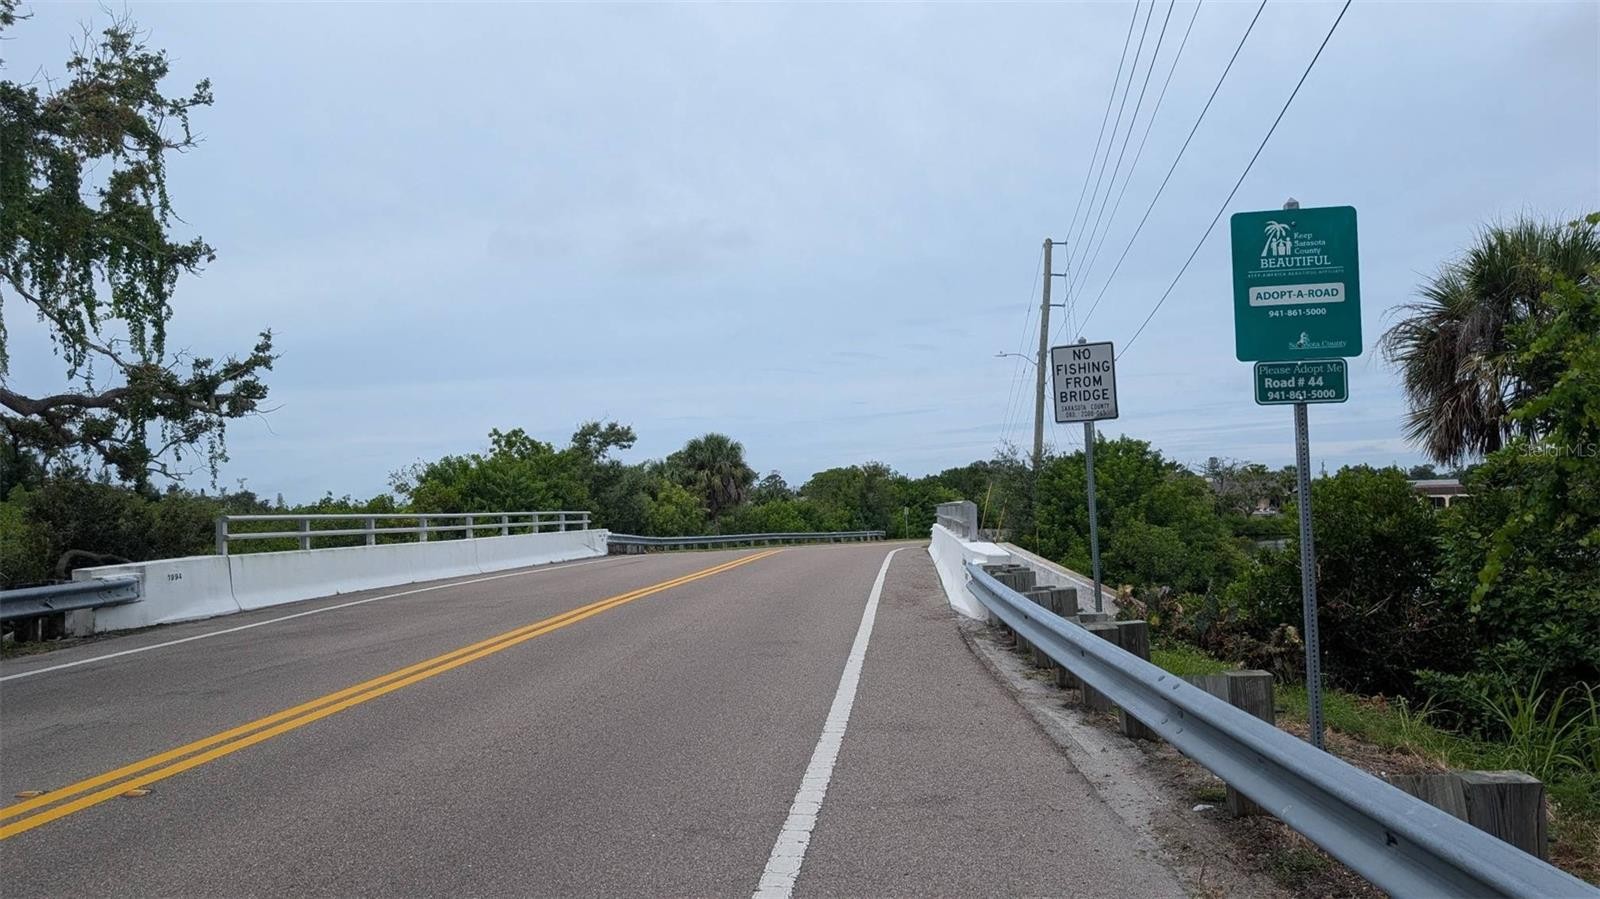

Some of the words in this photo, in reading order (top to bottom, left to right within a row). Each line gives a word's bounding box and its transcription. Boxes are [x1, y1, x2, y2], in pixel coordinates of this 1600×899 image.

[1294, 232, 1313, 240] Keep
[1294, 239, 1326, 247] Sarasota
[1294, 247, 1321, 255] County
[1260, 255, 1332, 269] BEAUTIFUL
[1255, 288, 1339, 301] ADOPT-A-ROAD
[1268, 307, 1327, 318] 941-861-5000
[1073, 348, 1091, 361] NO
[1056, 360, 1110, 376] FISHING
[1259, 366, 1291, 375] Please
[1293, 364, 1324, 375] Adopt
[1327, 363, 1343, 373] Me
[1065, 375, 1103, 389] FROM
[1264, 377, 1295, 388] Road
[1297, 377, 1305, 387] #
[1308, 376, 1324, 387] 44
[1060, 388, 1110, 403] BRIDGE
[1267, 389, 1336, 400] 941-861-5000
[1062, 404, 1087, 412] SARASOTA
